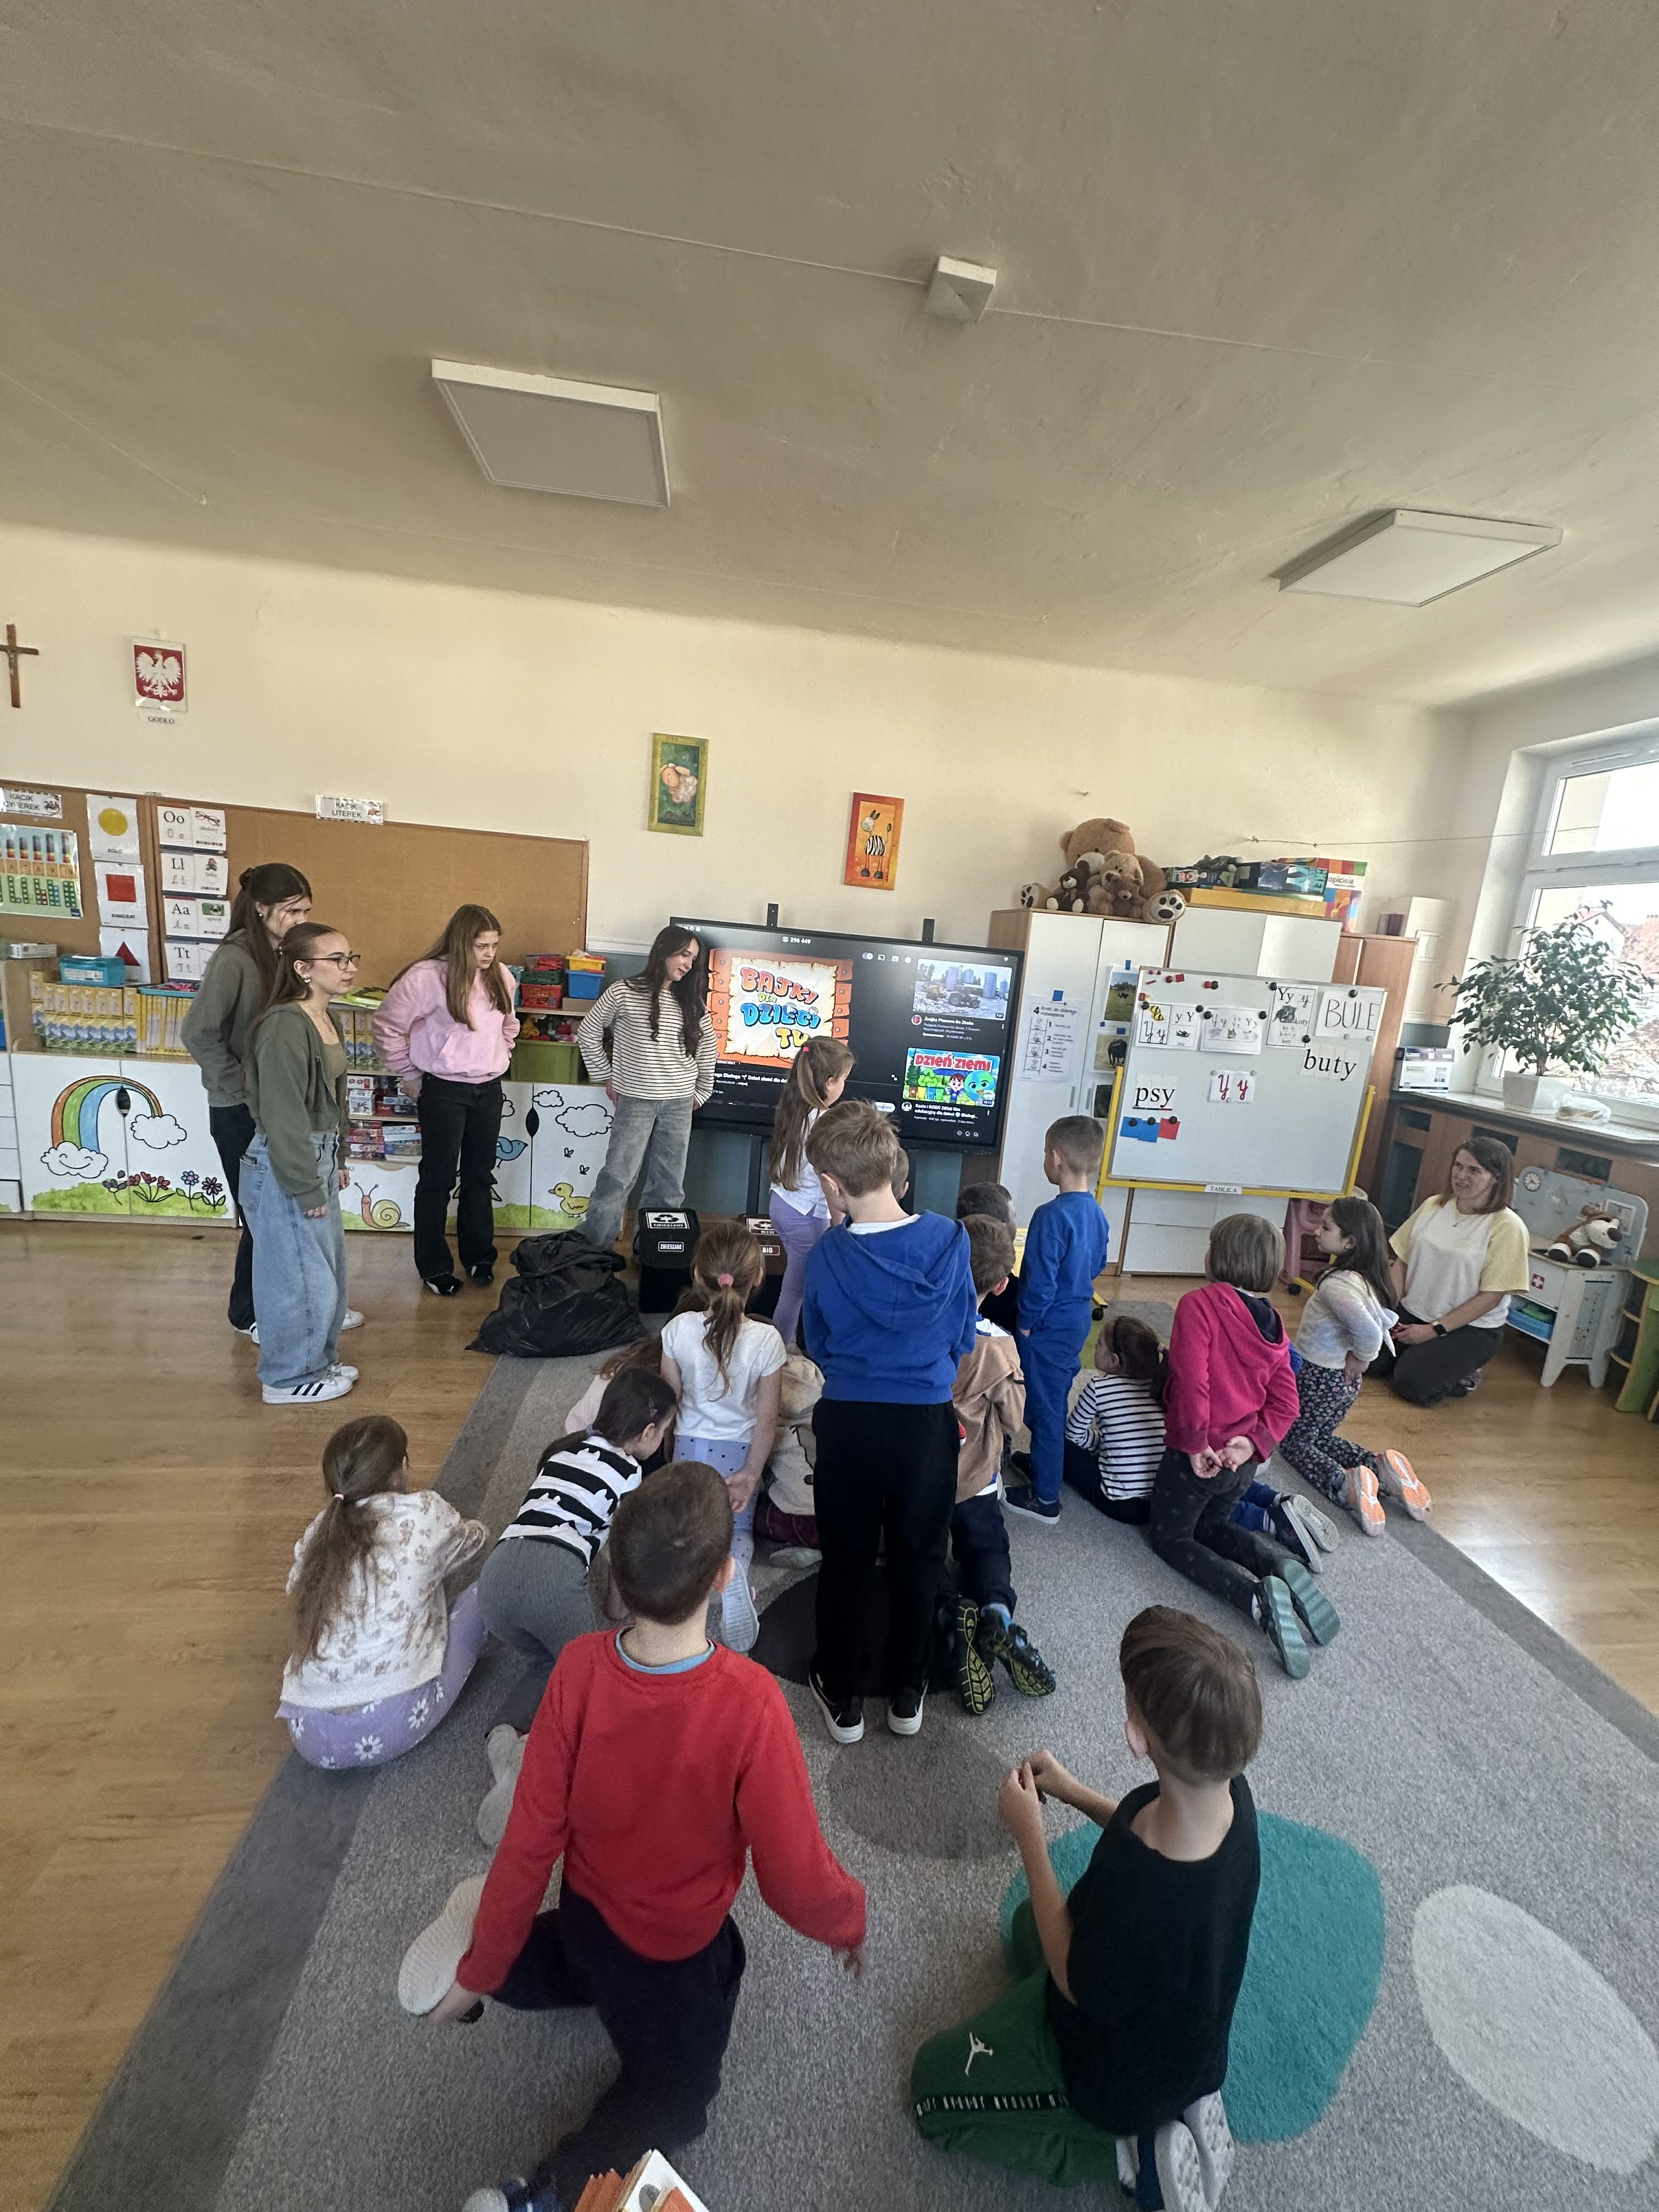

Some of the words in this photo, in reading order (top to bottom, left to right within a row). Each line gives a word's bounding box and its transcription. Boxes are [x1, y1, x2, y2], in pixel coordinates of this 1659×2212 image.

[164, 811, 184, 824] Oo
[332, 809, 362, 818] LITEREK
[171, 858, 184, 871] Ll
[171, 904, 190, 916] Aa
[174, 947, 190, 959] Tt
[741, 967, 819, 1005] BAJKI
[1278, 987, 1295, 1005] Yy
[741, 1002, 821, 1030] DZIECI
[1033, 1006, 1040, 1014] 4
[1294, 1018, 1309, 1027] koty
[1304, 1048, 1357, 1081] buty
[1133, 1086, 1176, 1108] psy
[1238, 1080, 1249, 1101] y
